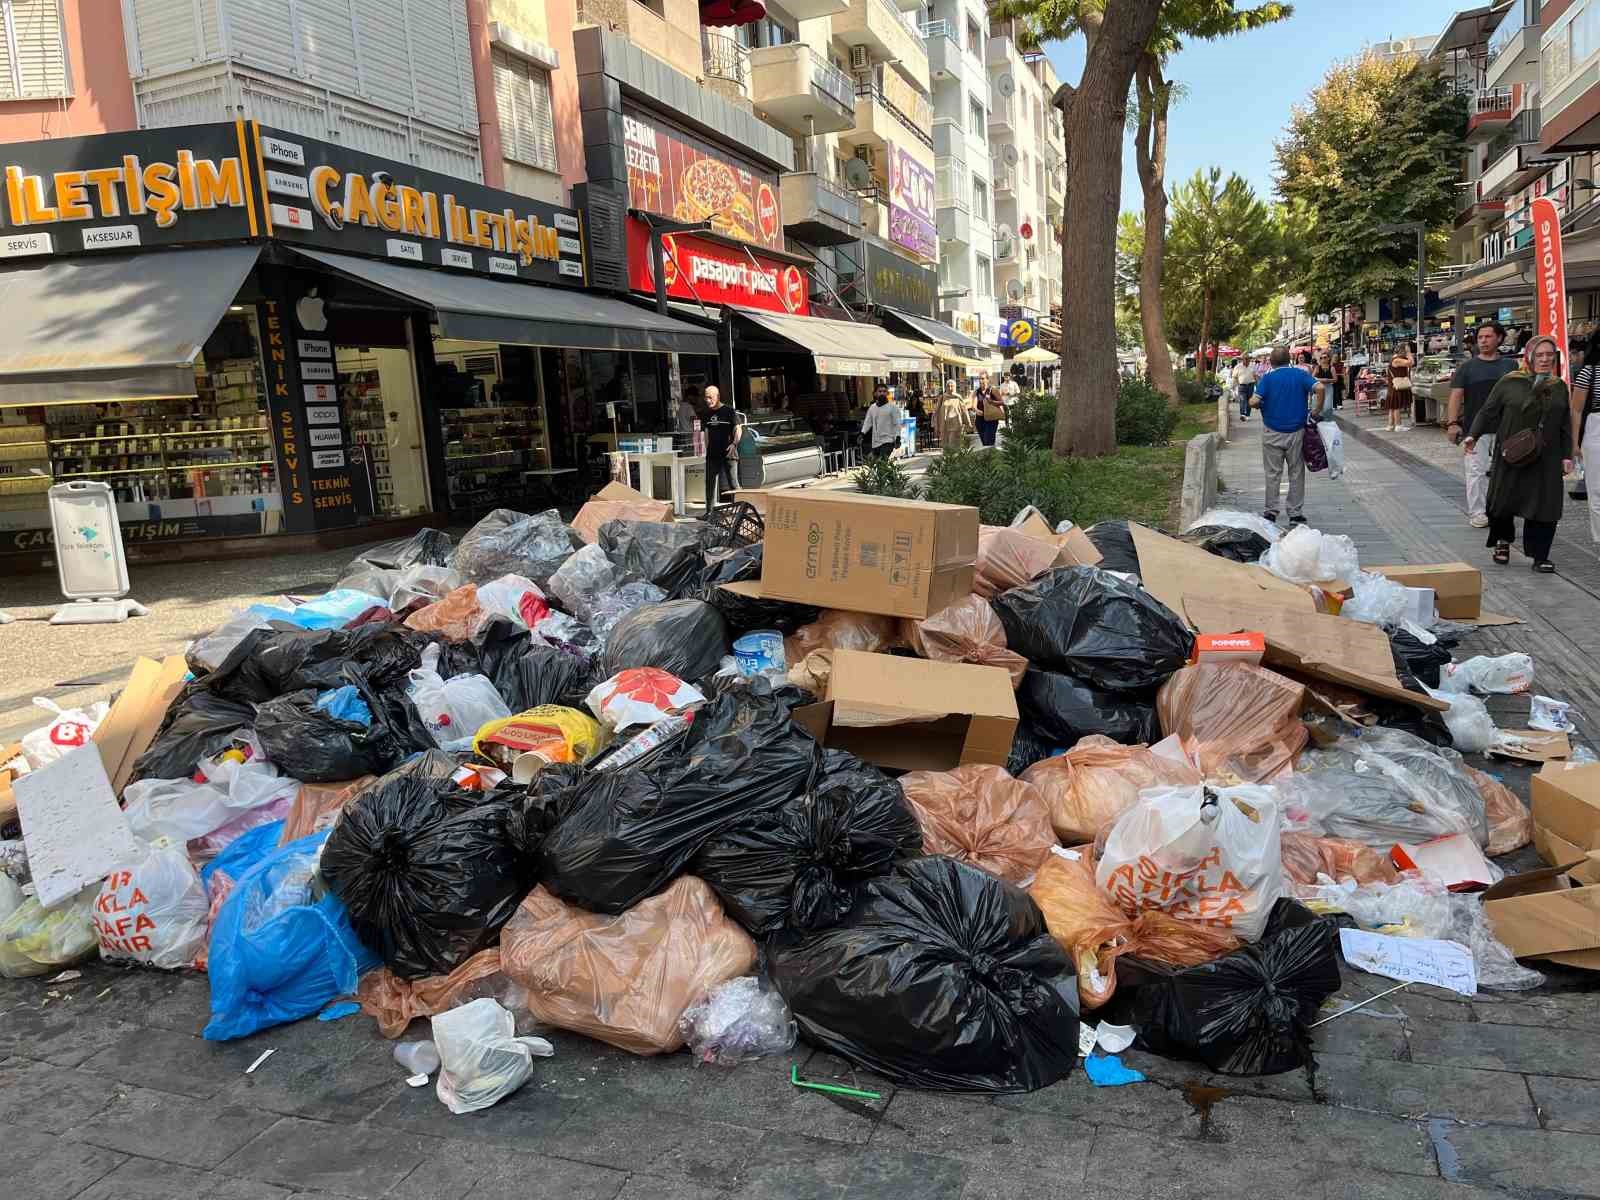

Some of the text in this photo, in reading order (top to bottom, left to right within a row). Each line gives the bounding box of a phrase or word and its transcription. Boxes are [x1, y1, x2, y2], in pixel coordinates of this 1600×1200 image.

[270, 142, 299, 160] iPhone
[5, 149, 245, 229] İLETİŞİM
[86, 230, 133, 243] AKSESUAR
[443, 193, 560, 266] İLETİŞİM
[8, 238, 38, 250] SERVİS
[692, 257, 748, 288] pasaport
[304, 343, 328, 353] iPhone
[314, 431, 341, 441] HUAWEI
